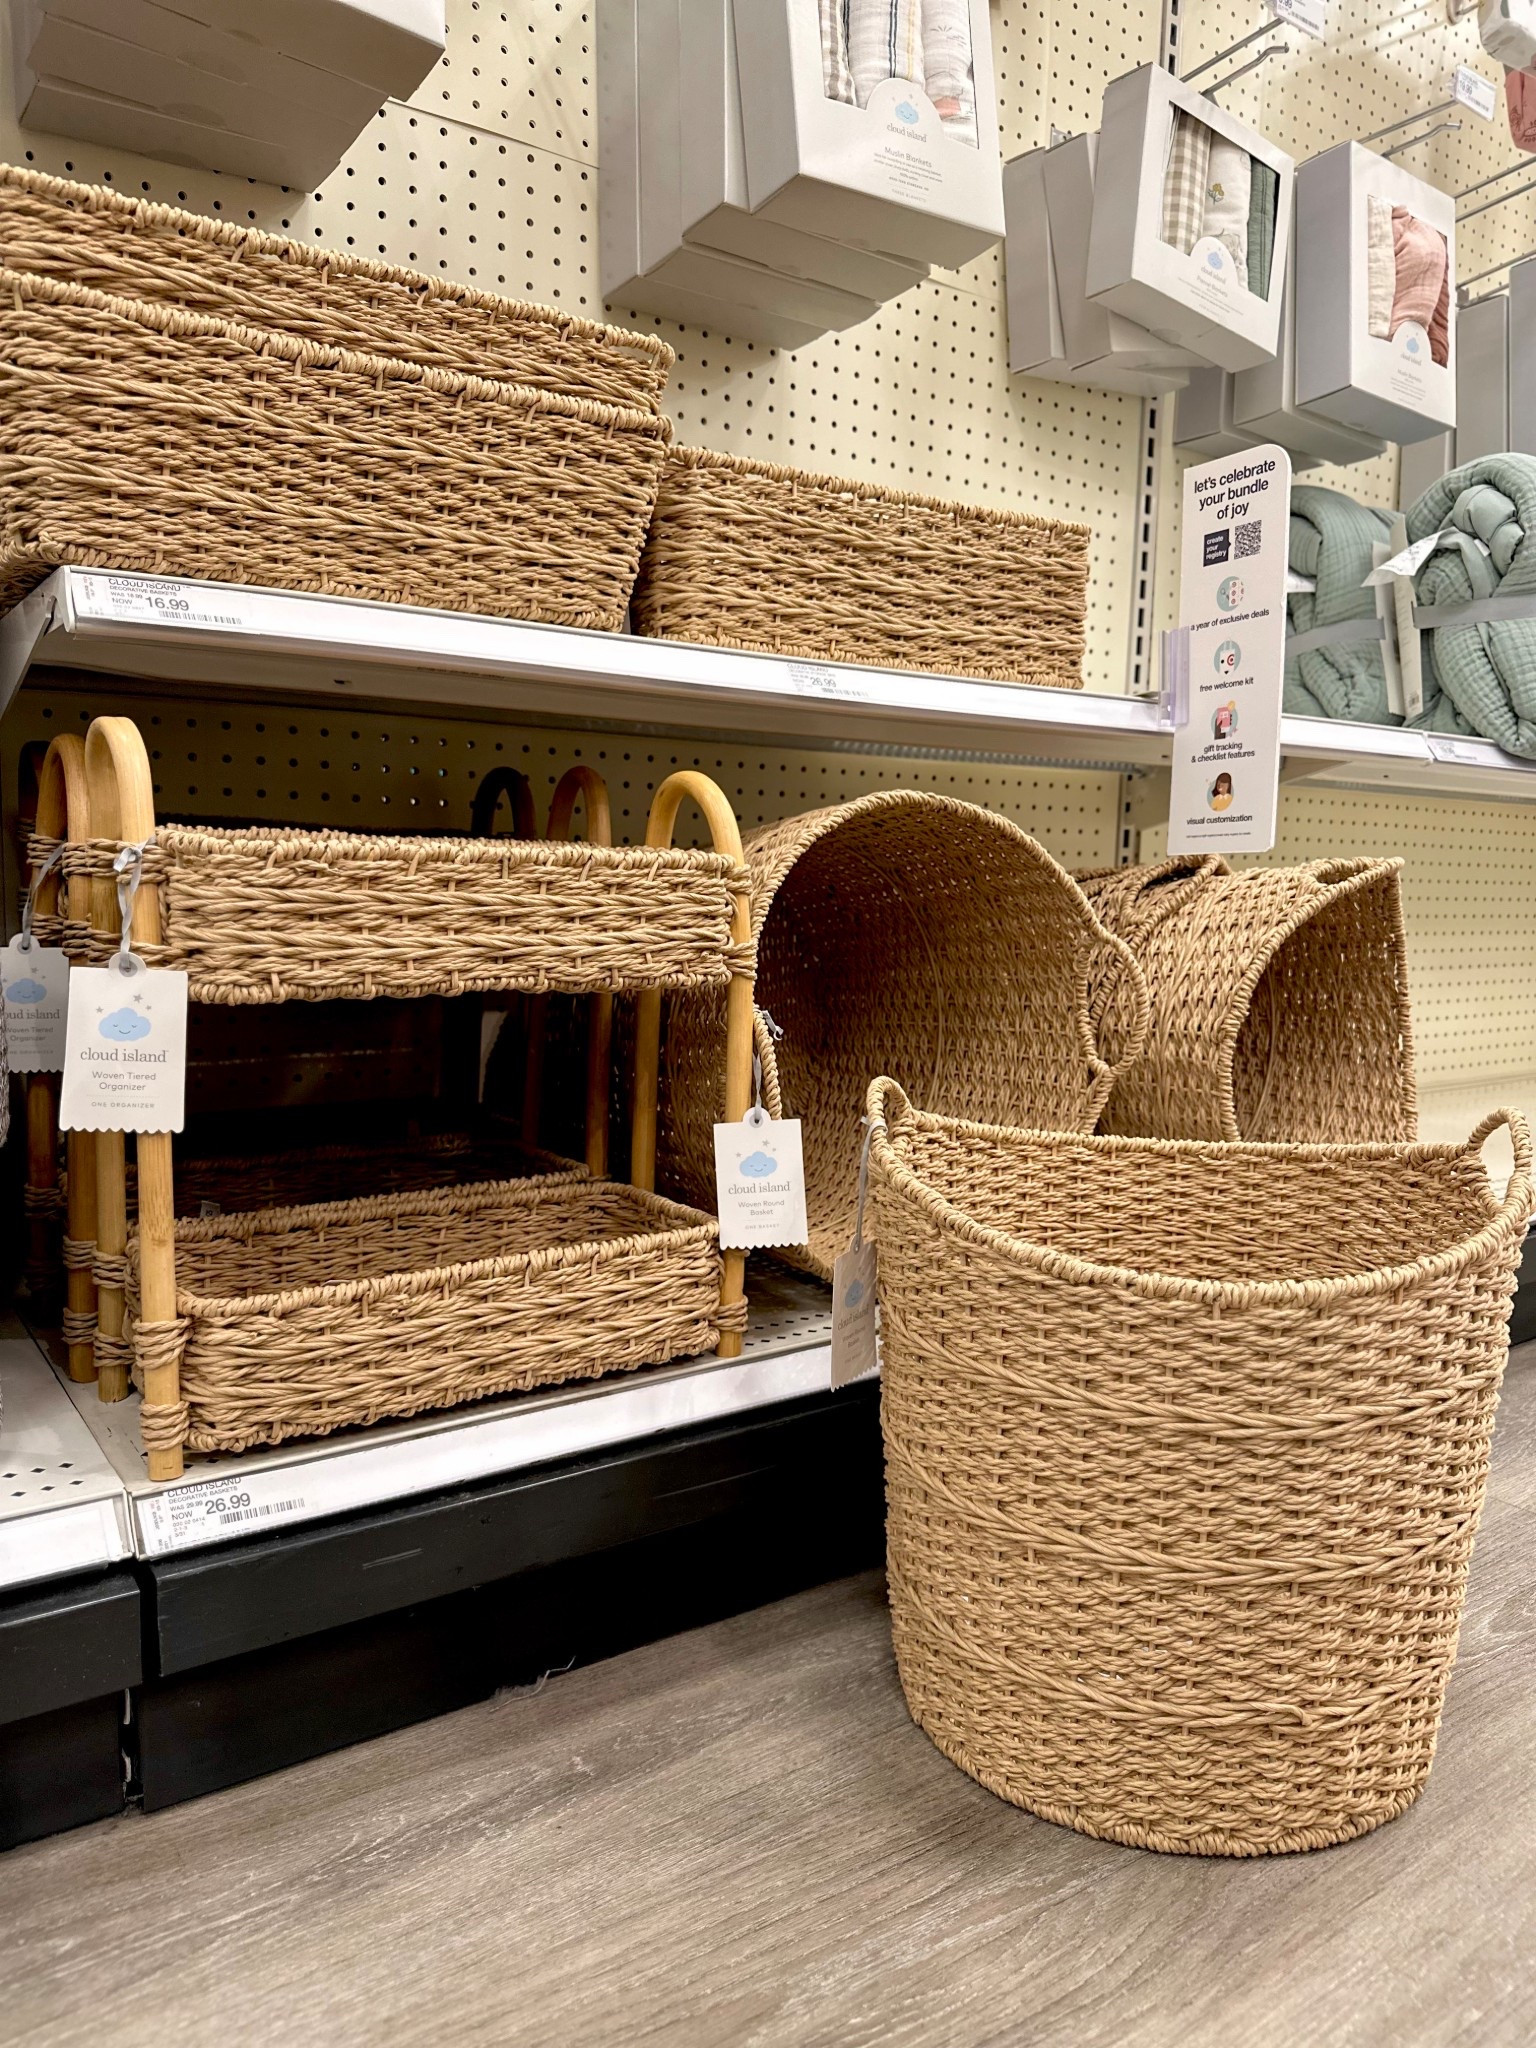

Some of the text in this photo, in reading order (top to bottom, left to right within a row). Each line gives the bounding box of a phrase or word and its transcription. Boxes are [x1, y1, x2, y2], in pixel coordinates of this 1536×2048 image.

[887, 123, 927, 142] cloud island
[884, 146, 904, 158] Muslin
[906, 153, 932, 168] Blankets
[1219, 460, 1276, 486] celebrate
[1199, 478, 1268, 512] your bundle
[1216, 502, 1250, 520] of joy
[1206, 536, 1224, 545] create
[1206, 544, 1218, 554] your
[1206, 550, 1227, 560] registry
[145, 596, 189, 612] 16.99
[1196, 621, 1210, 631] year
[1211, 618, 1218, 626] of
[1219, 612, 1250, 626] exclusive
[1250, 608, 1270, 619] deals
[1200, 676, 1254, 693] free welcome kit
[1203, 742, 1243, 754] gift tracking
[1190, 750, 1255, 763] & checklist features
[1186, 813, 1253, 826] visual customization
[26, 1008, 60, 1020] island
[80, 1047, 167, 1063] cloud island
[92, 1071, 156, 1080] Woven Tiered
[99, 1082, 146, 1092] Organizer
[728, 1180, 790, 1194] cloud island
[838, 1313, 852, 1331] cloud
[168, 1477, 242, 1498] CLOUD ISLAND
[168, 1486, 238, 1504] DECORATIVE BASKETS
[170, 1504, 185, 1512] WAS
[205, 1492, 251, 1516] 26.99
[172, 1510, 193, 1520] NOW
